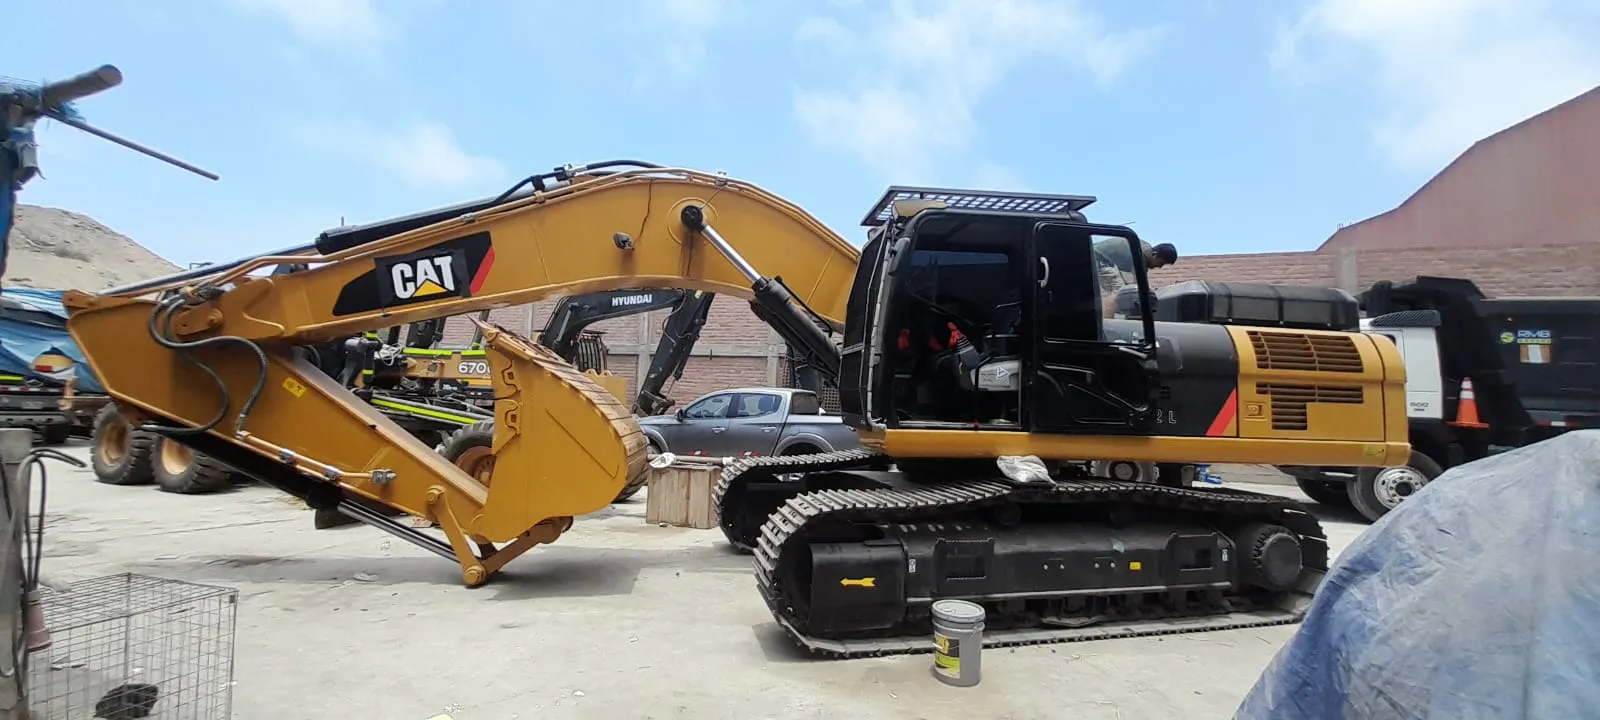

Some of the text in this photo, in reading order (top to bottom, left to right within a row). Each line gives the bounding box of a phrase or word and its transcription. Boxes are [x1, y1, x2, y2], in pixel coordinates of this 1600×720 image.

[391, 255, 455, 299] CAT
[611, 294, 653, 307] HYUNDAI
[458, 361, 491, 374] 670
[1168, 410, 1177, 424] L
